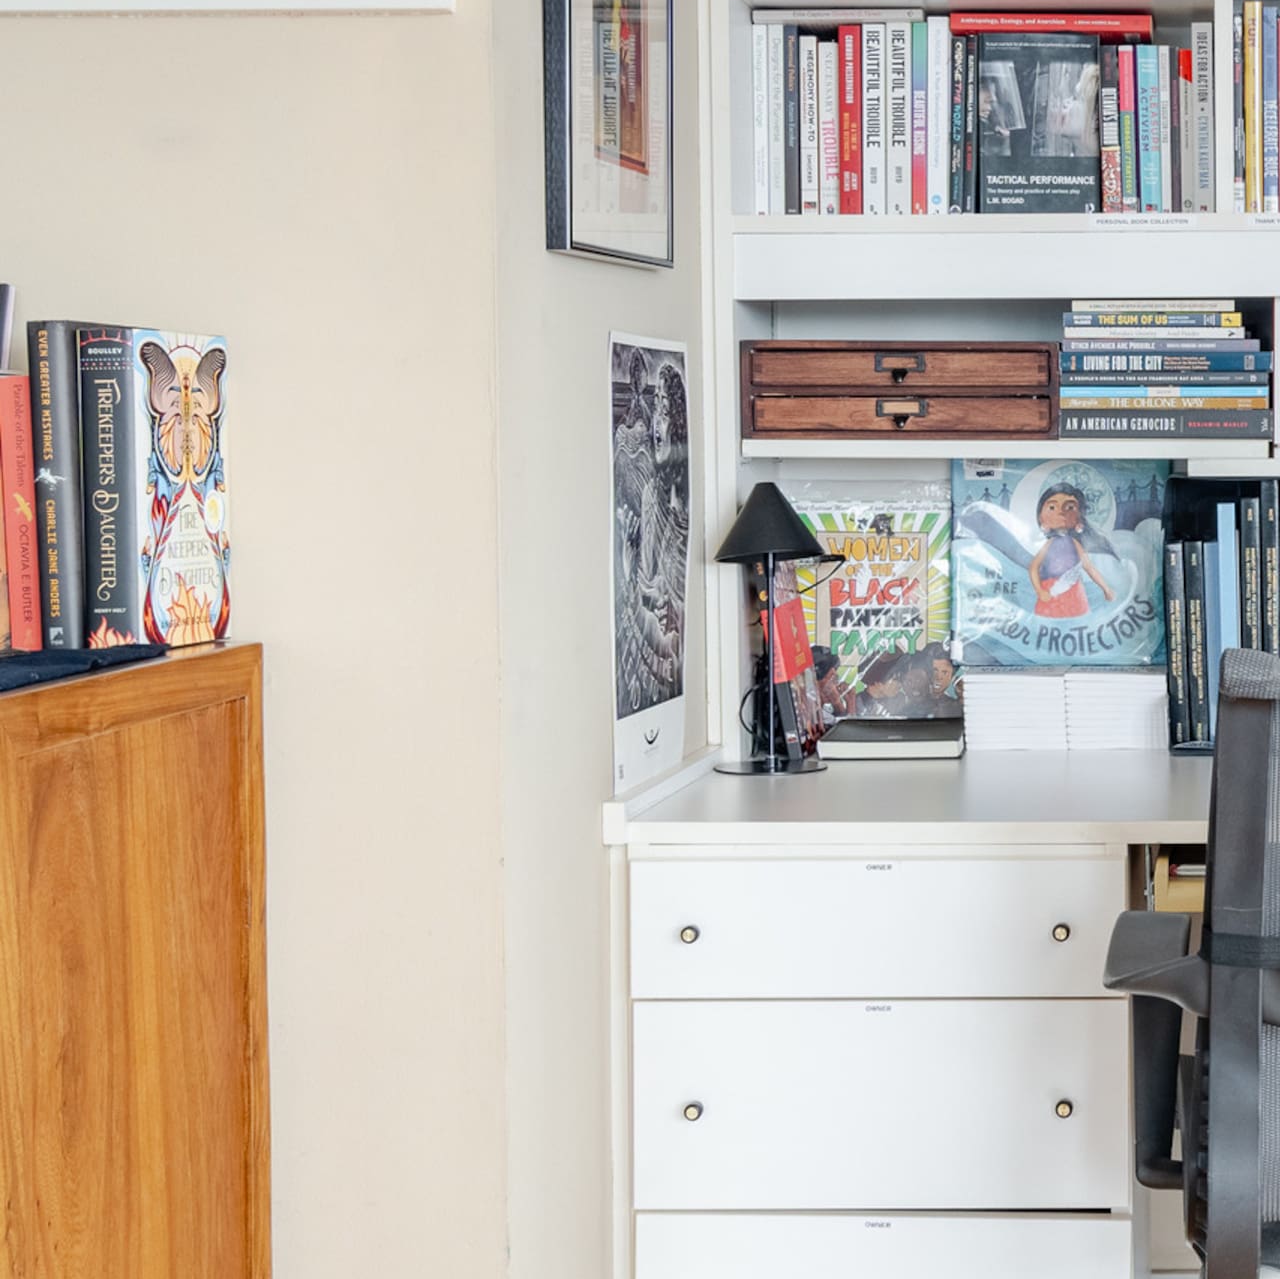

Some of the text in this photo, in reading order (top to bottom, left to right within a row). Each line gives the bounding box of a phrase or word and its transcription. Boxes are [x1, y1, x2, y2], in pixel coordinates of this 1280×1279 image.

[866, 30, 880, 148] BEAUTIFUL TROUBLE
[892, 29, 905, 147] BEAUTIFUL TROUBLE
[87, 347, 123, 356] BOULLEY
[1083, 356, 1163, 370] LIVING FOR THE CITY
[38, 329, 53, 461] EVEN GREATER MISTAKES
[1066, 418, 1176, 431] AN AMERICAN GENOCIDE
[92, 377, 121, 601] FIREKEEPER'S DAUGHTER
[45, 499, 61, 619] CHARLIE JANE ANDERS
[827, 537, 921, 561] WOMEN
[19, 524, 33, 624] OCTAVIA E. BUTLER
[993, 582, 1017, 594] ARE
[829, 578, 920, 606] BLACK
[830, 608, 923, 628] PANTHER
[1036, 596, 1156, 657] PROTECTORS
[830, 629, 923, 655] PARTY
